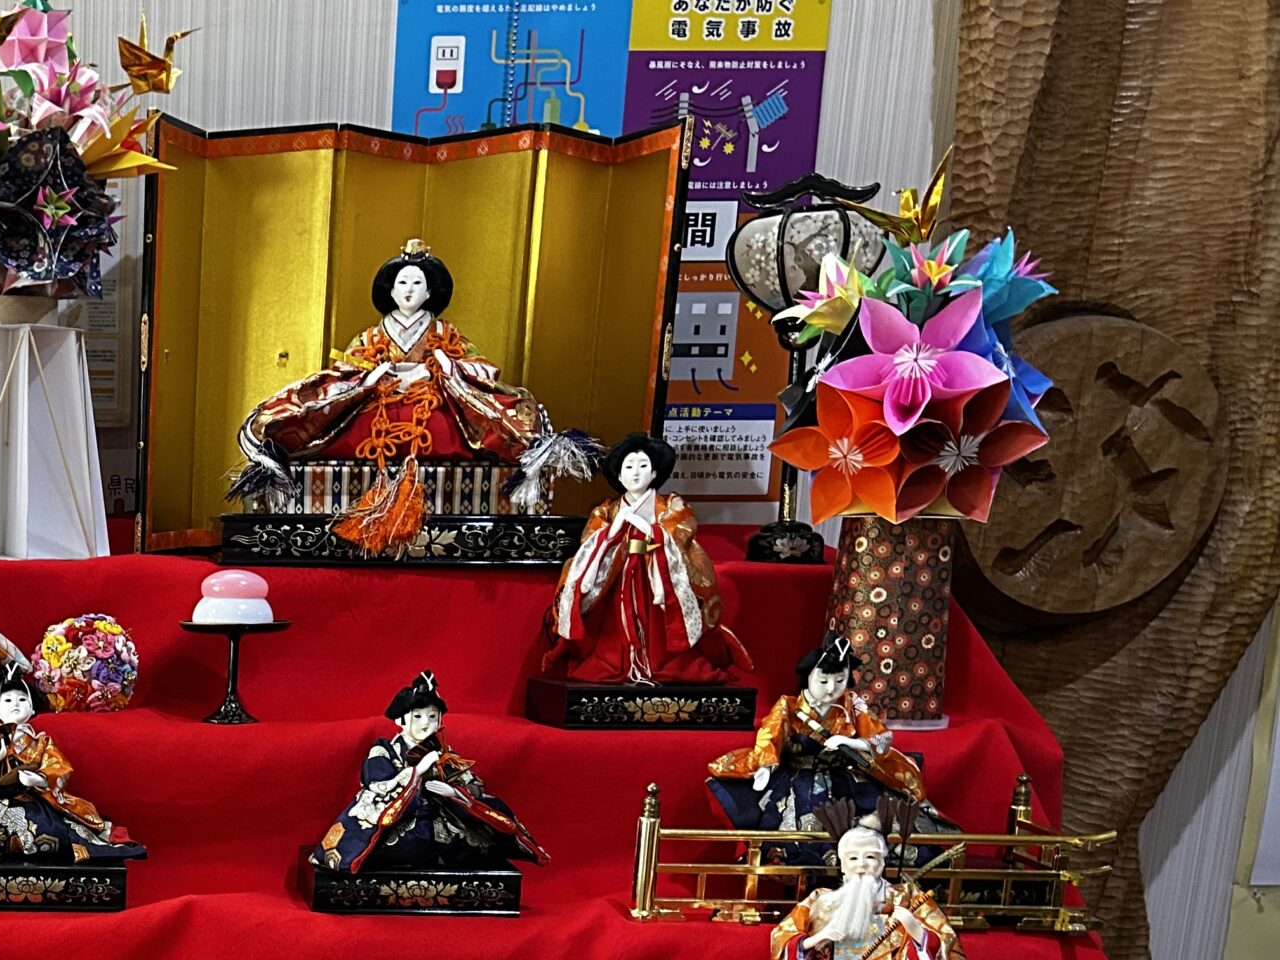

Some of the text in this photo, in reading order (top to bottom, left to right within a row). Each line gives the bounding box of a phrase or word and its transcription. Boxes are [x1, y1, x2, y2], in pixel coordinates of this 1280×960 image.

[671, 20, 792, 38] 電気事故
[682, 212, 717, 249] 間
